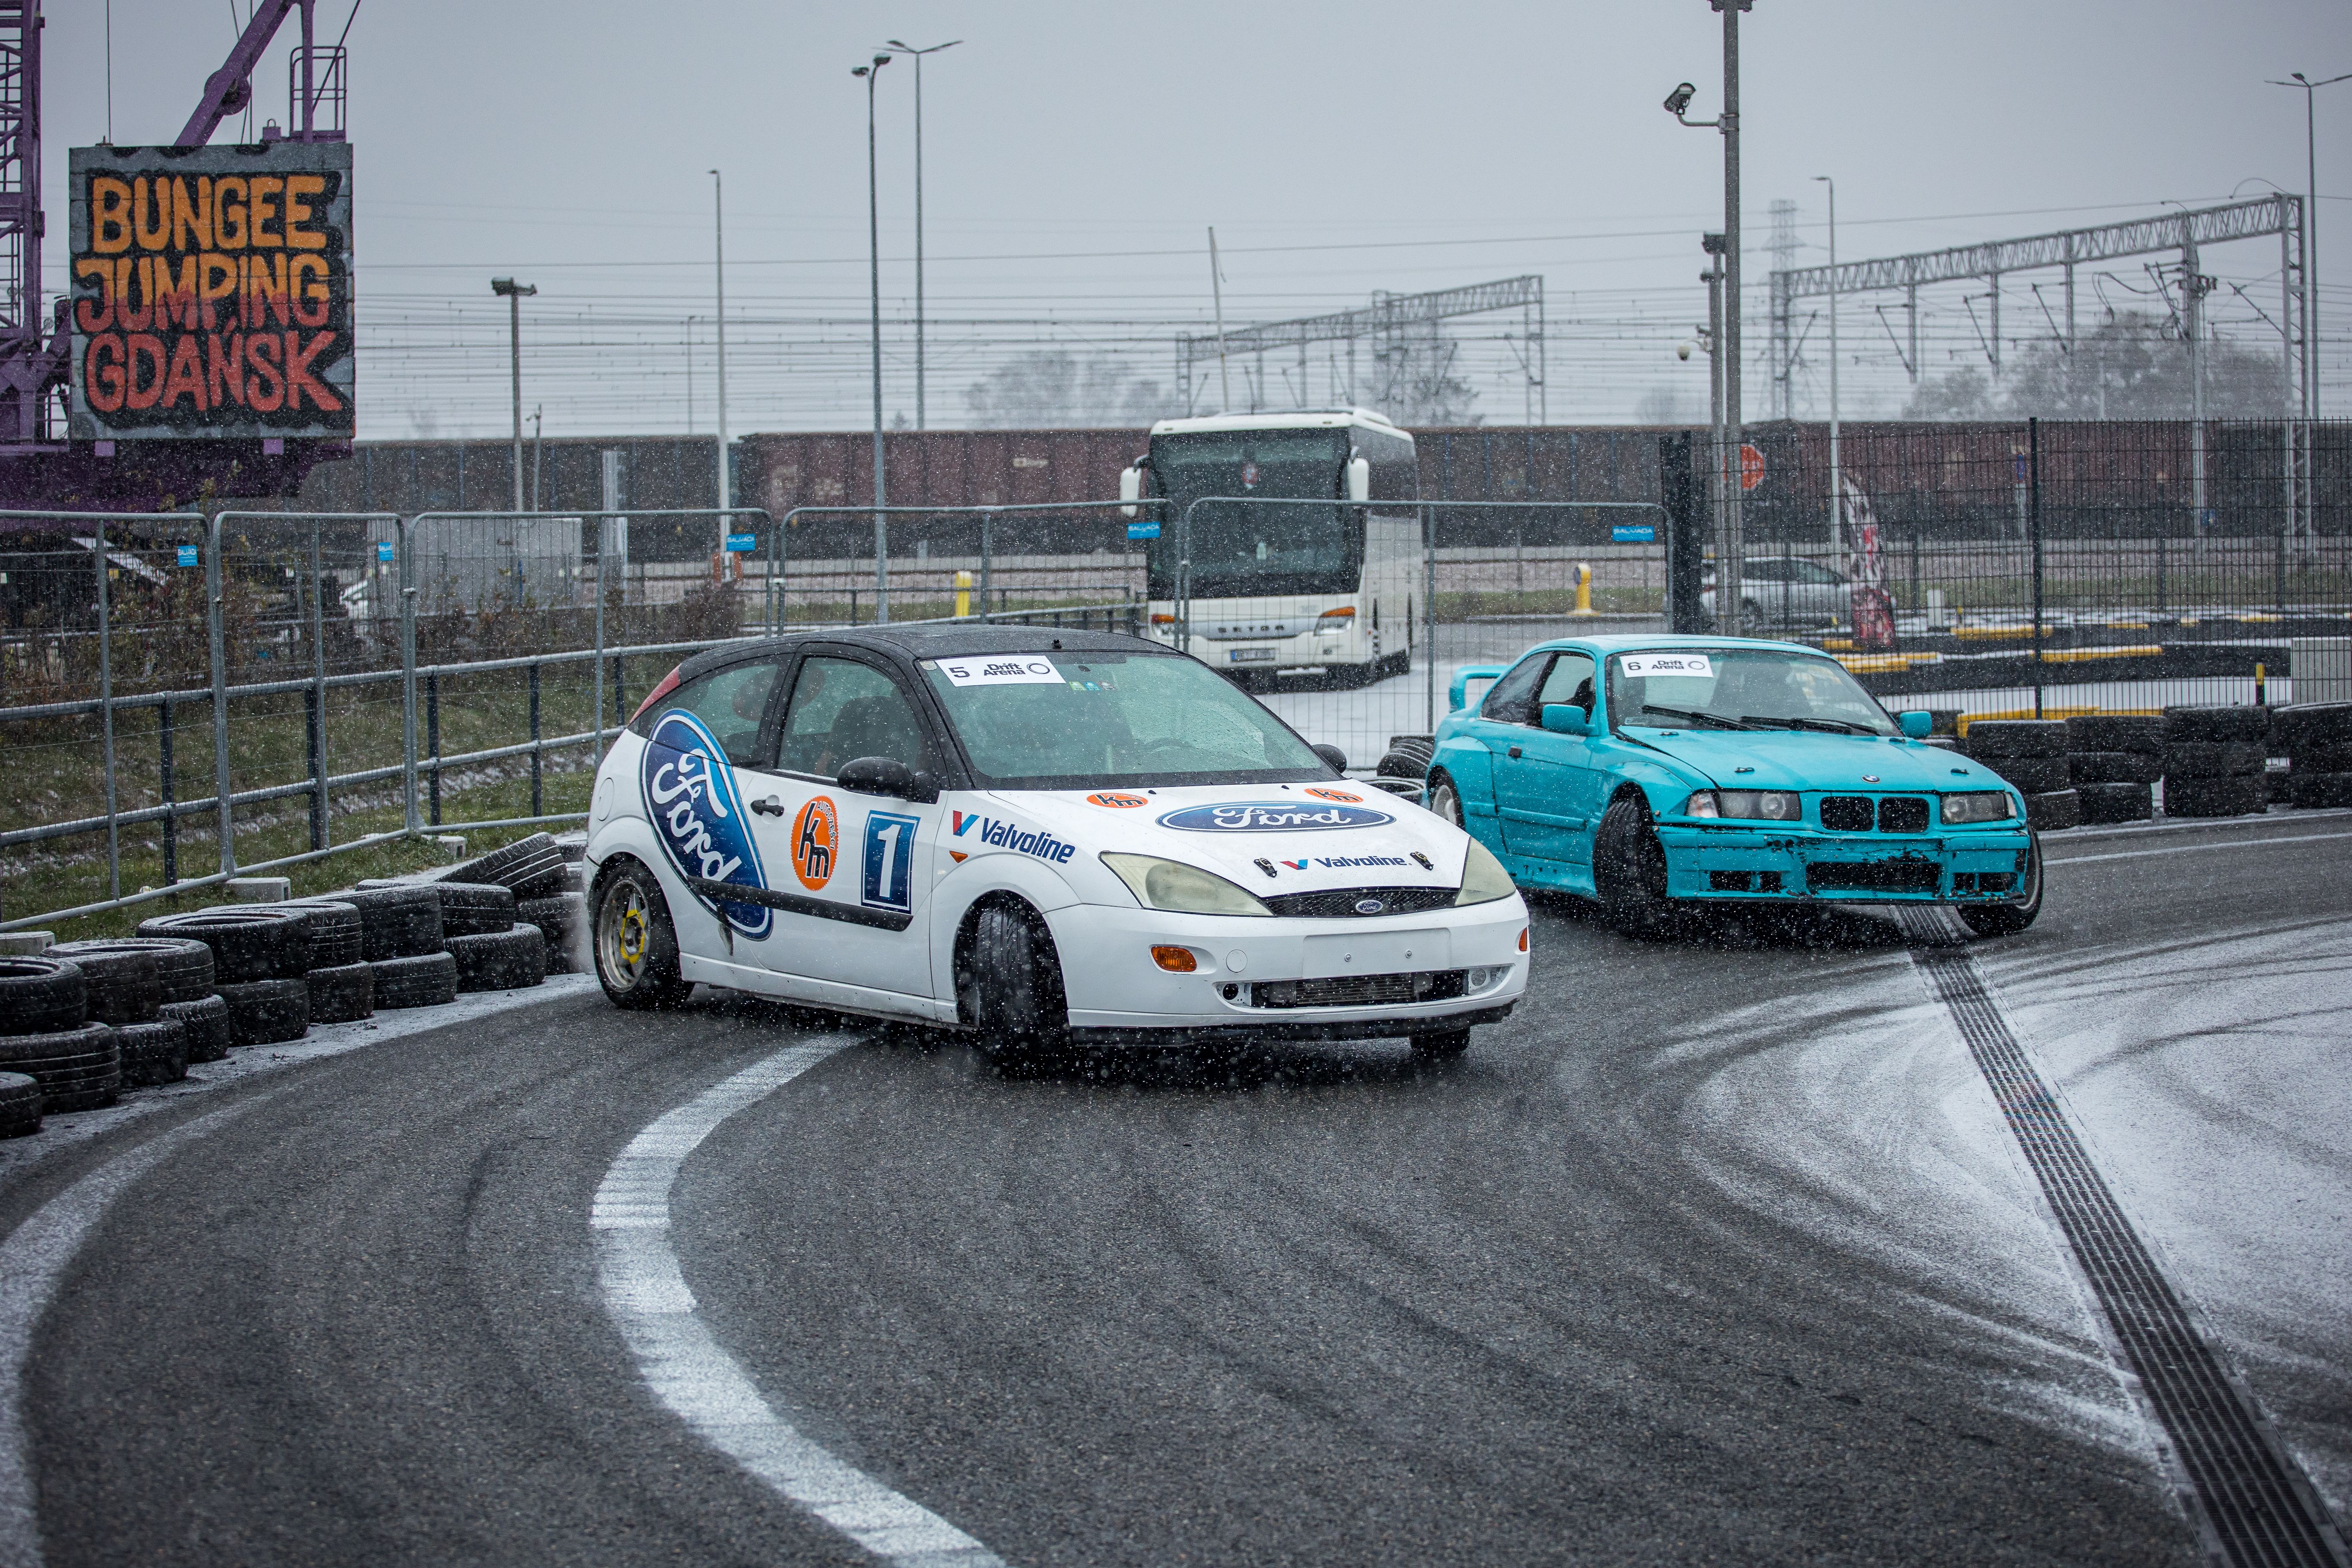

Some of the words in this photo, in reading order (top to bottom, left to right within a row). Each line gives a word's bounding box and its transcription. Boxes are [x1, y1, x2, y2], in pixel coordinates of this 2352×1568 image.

[92, 175, 328, 253] BUNGEE
[76, 252, 330, 332] JUMPING
[86, 316, 343, 413] GDAŃSK
[949, 667, 971, 678] 5
[987, 663, 1022, 671] Drift
[1627, 662, 1642, 671] 6
[652, 748, 742, 882] Ford
[1212, 805, 1352, 828] Ford
[877, 824, 902, 899] 1
[981, 817, 1075, 864] Valvoline
[1314, 856, 1407, 868] Valvoline
